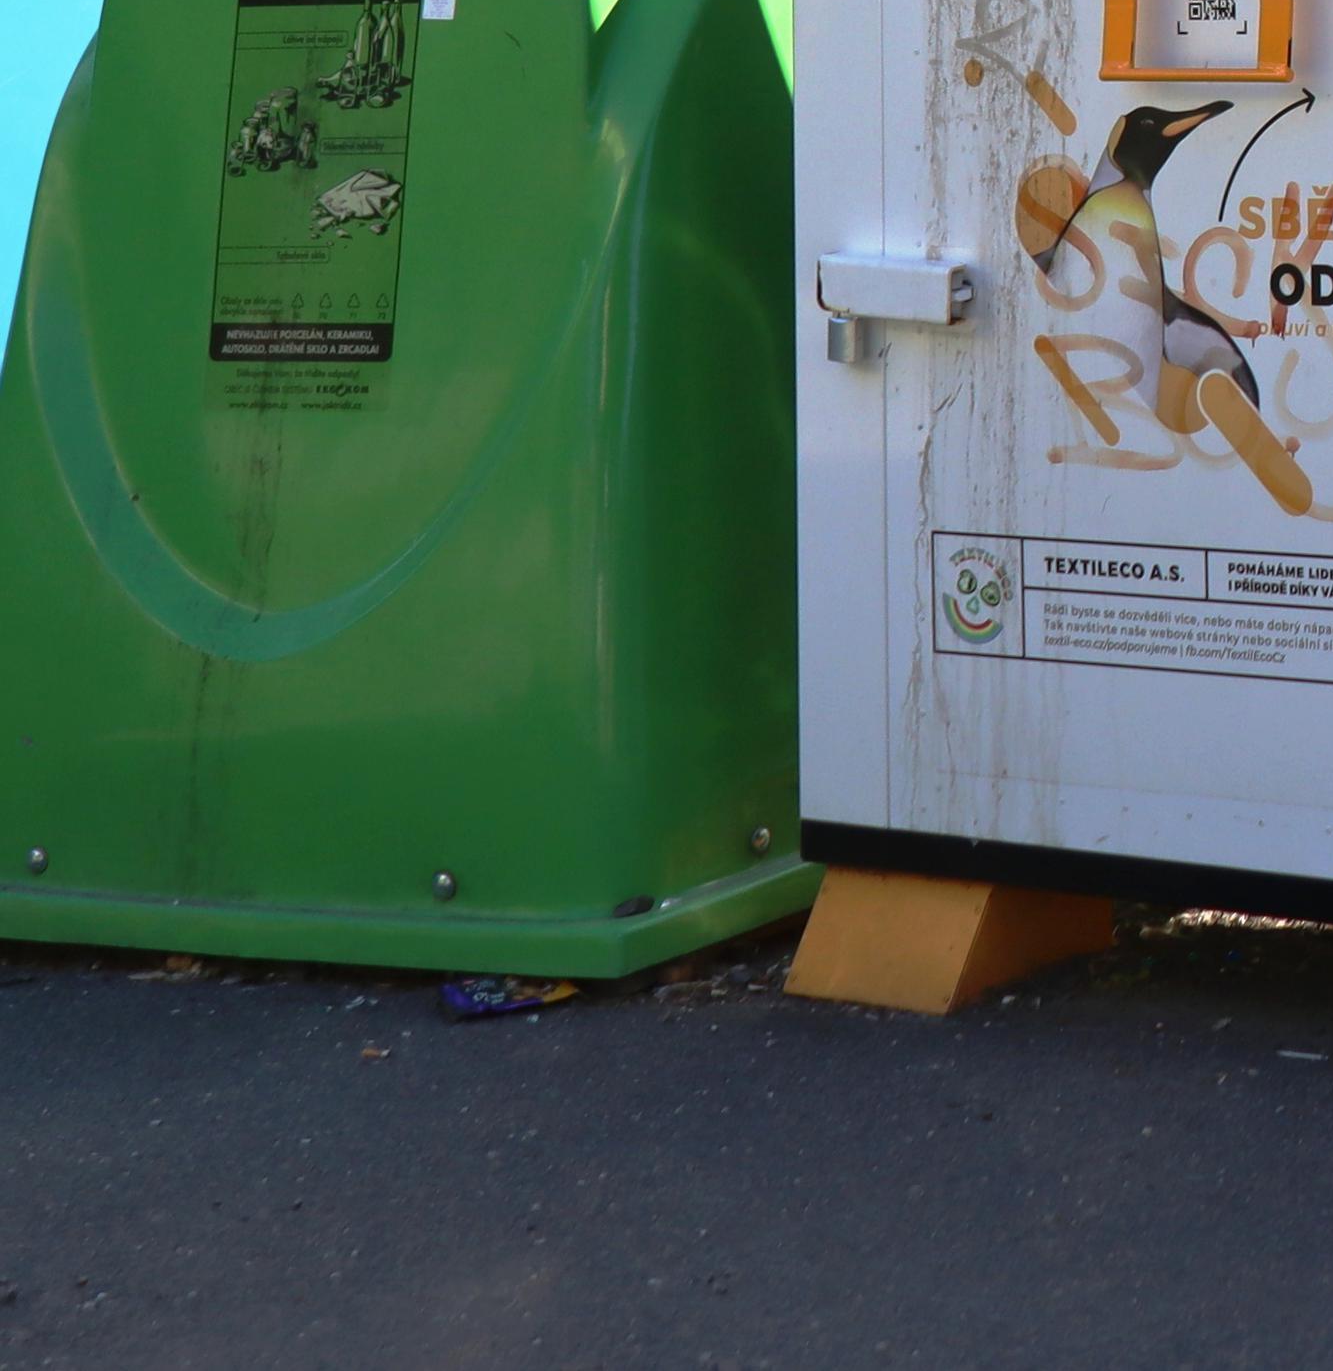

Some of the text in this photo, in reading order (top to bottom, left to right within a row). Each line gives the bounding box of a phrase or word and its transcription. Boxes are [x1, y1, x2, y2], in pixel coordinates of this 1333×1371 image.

[1315, 321, 1329, 336] a
[1044, 556, 1185, 582] TEXTILECO A.S.
[1227, 561, 1305, 579] POMÁHÁME
[1227, 580, 1233, 592] I
[1233, 578, 1287, 597] PŘÍRODĚ
[1289, 580, 1319, 597] DÍKY
[1070, 605, 1102, 619] byste
[1103, 609, 1116, 619] se
[1203, 613, 1232, 628] nebo
[1234, 615, 1265, 629] máte
[1267, 617, 1301, 635] dobrý
[1119, 622, 1148, 637] naše
[1150, 625, 1193, 641] webové
[1196, 629, 1240, 646] stránky
[1242, 632, 1272, 648] nebo
